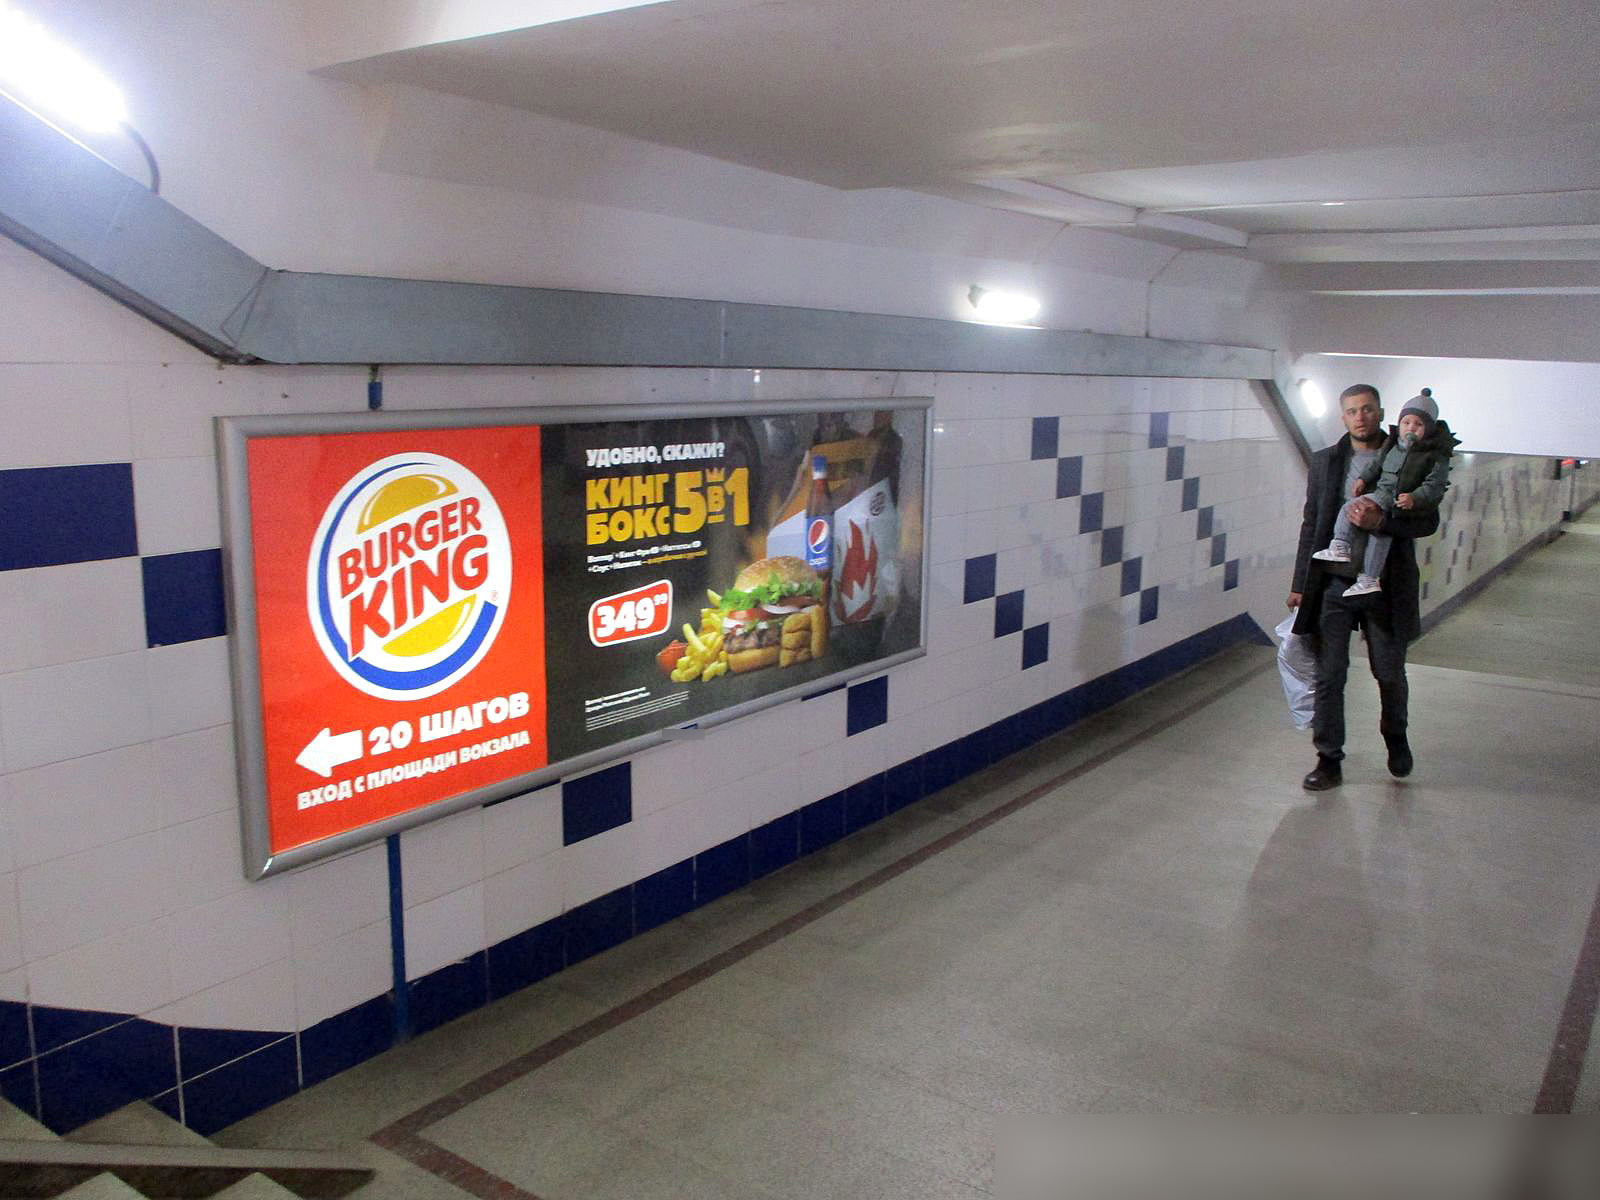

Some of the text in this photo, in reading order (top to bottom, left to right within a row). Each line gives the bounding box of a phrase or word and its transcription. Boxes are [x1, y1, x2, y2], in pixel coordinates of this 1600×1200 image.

[586, 442, 726, 468] УДОБНО, СКАЖИ?
[586, 473, 670, 511] КИНГ
[674, 470, 708, 534] 5
[723, 467, 750, 526] 1
[338, 496, 482, 599] BURGER
[586, 506, 671, 545] БОКС
[347, 533, 489, 661] KING
[368, 691, 531, 756] 20 ШАГОВ
[297, 730, 531, 810] ВХОД С ПЛОЩАДИ ВОКЗАЛА
